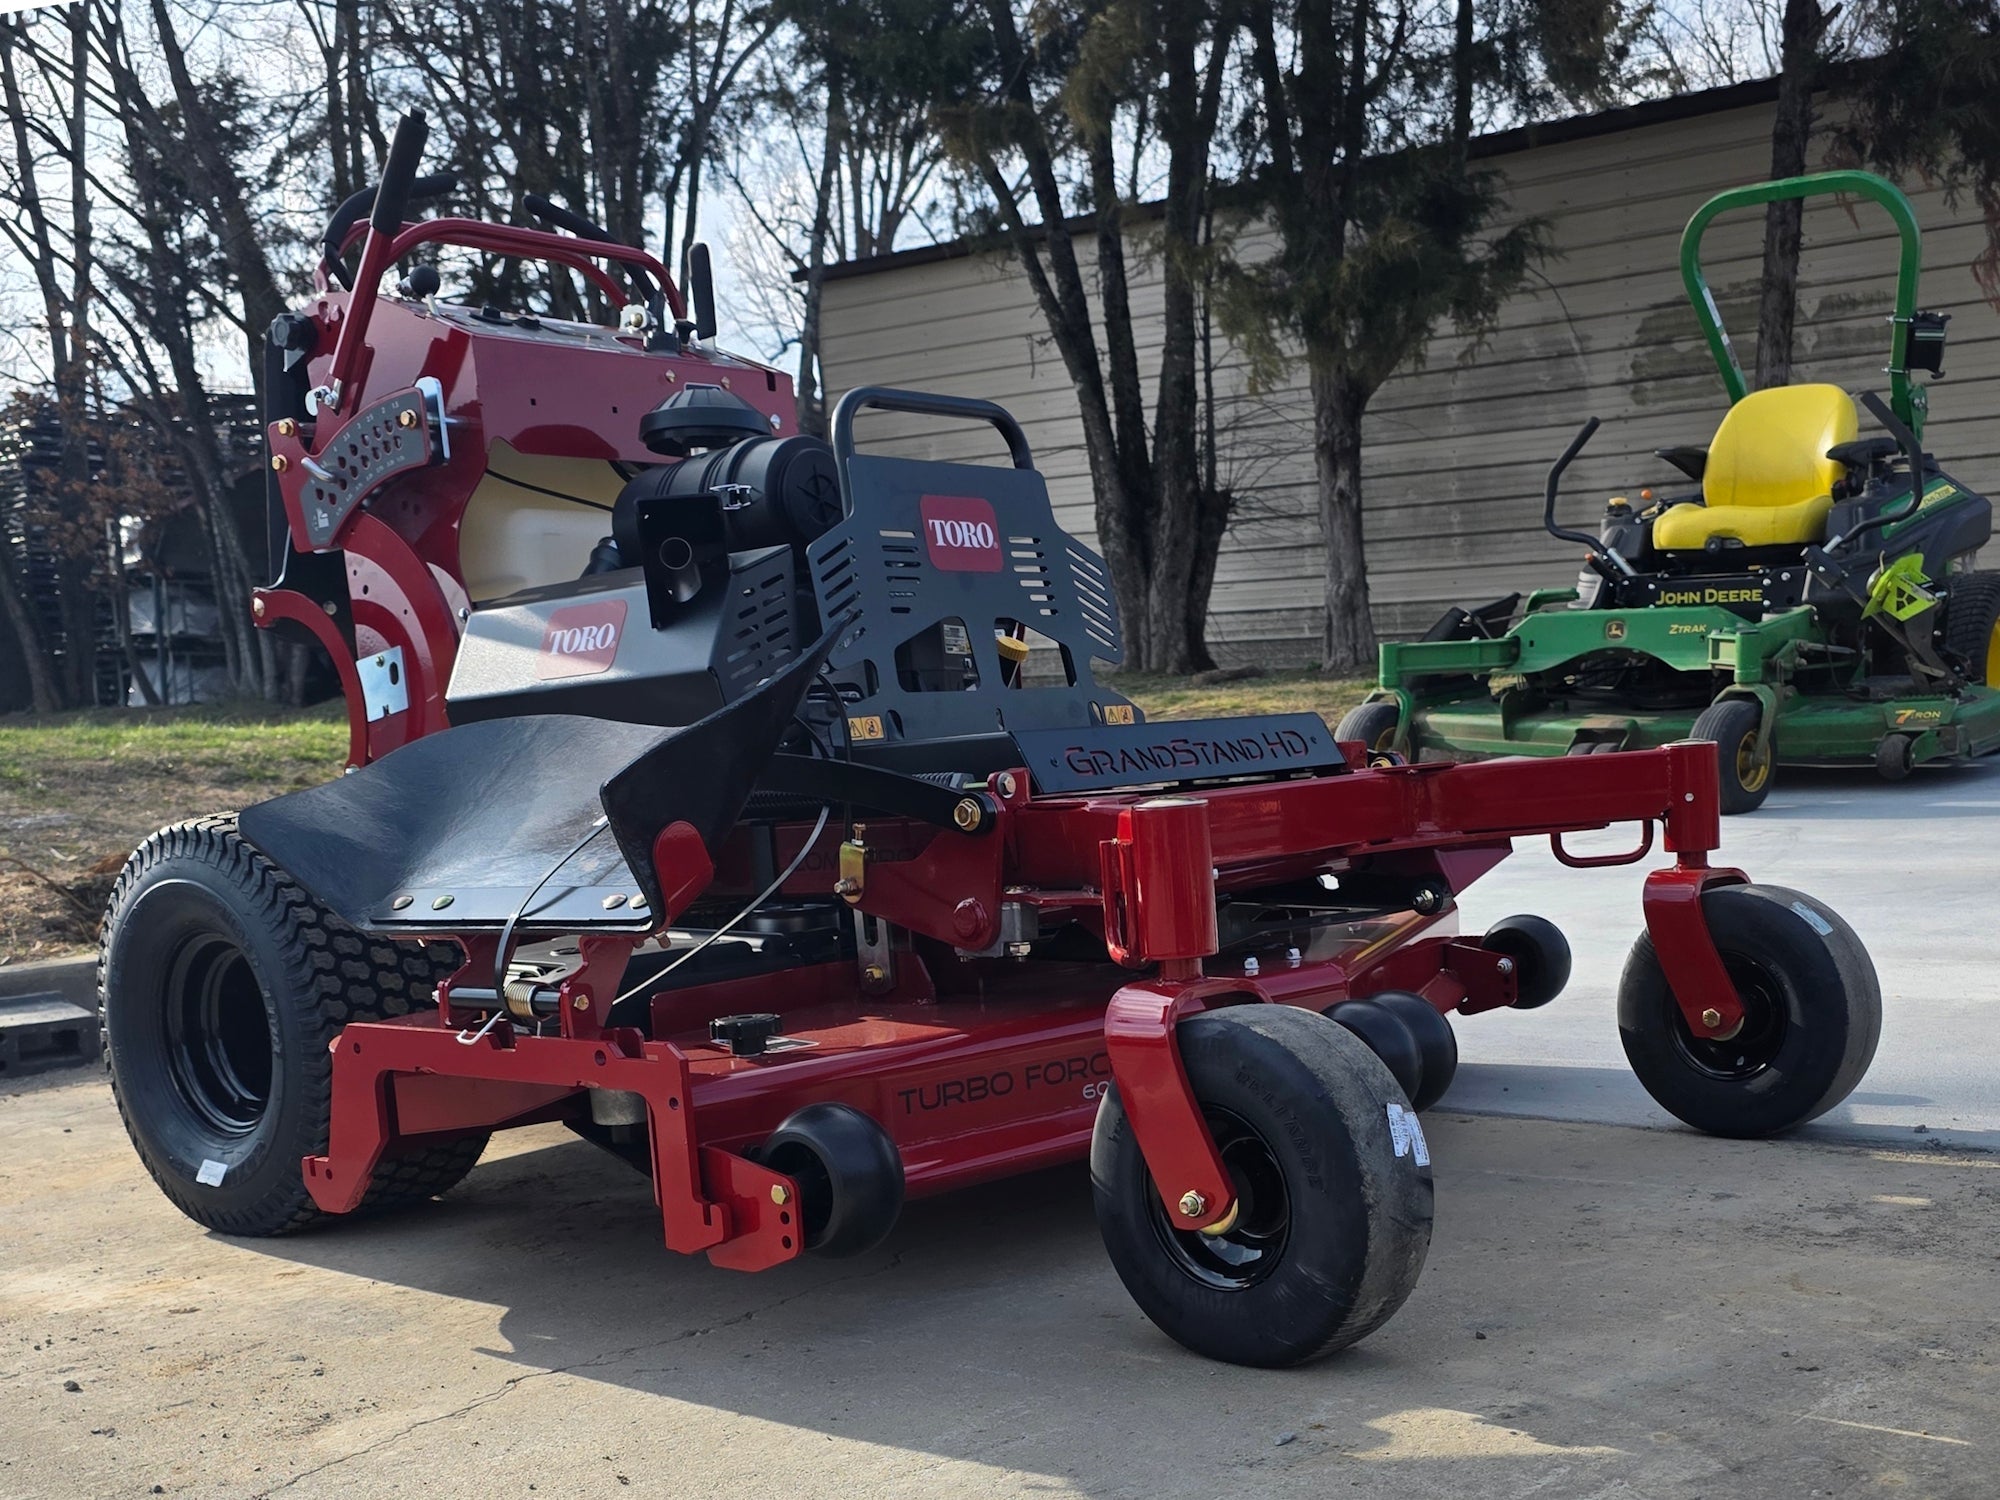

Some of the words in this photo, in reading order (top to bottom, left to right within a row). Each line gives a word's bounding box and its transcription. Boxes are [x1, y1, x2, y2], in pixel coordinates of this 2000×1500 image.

[928, 519, 995, 549] TORO
[1655, 590, 1701, 605] JOHN
[1704, 588, 1763, 603] DEERE
[548, 622, 616, 656] TORO
[1668, 624, 1707, 635] ZTRAK
[1261, 730, 1310, 759] HD
[898, 1071, 1014, 1114] TURBO
[1024, 1052, 1114, 1090] FORC
